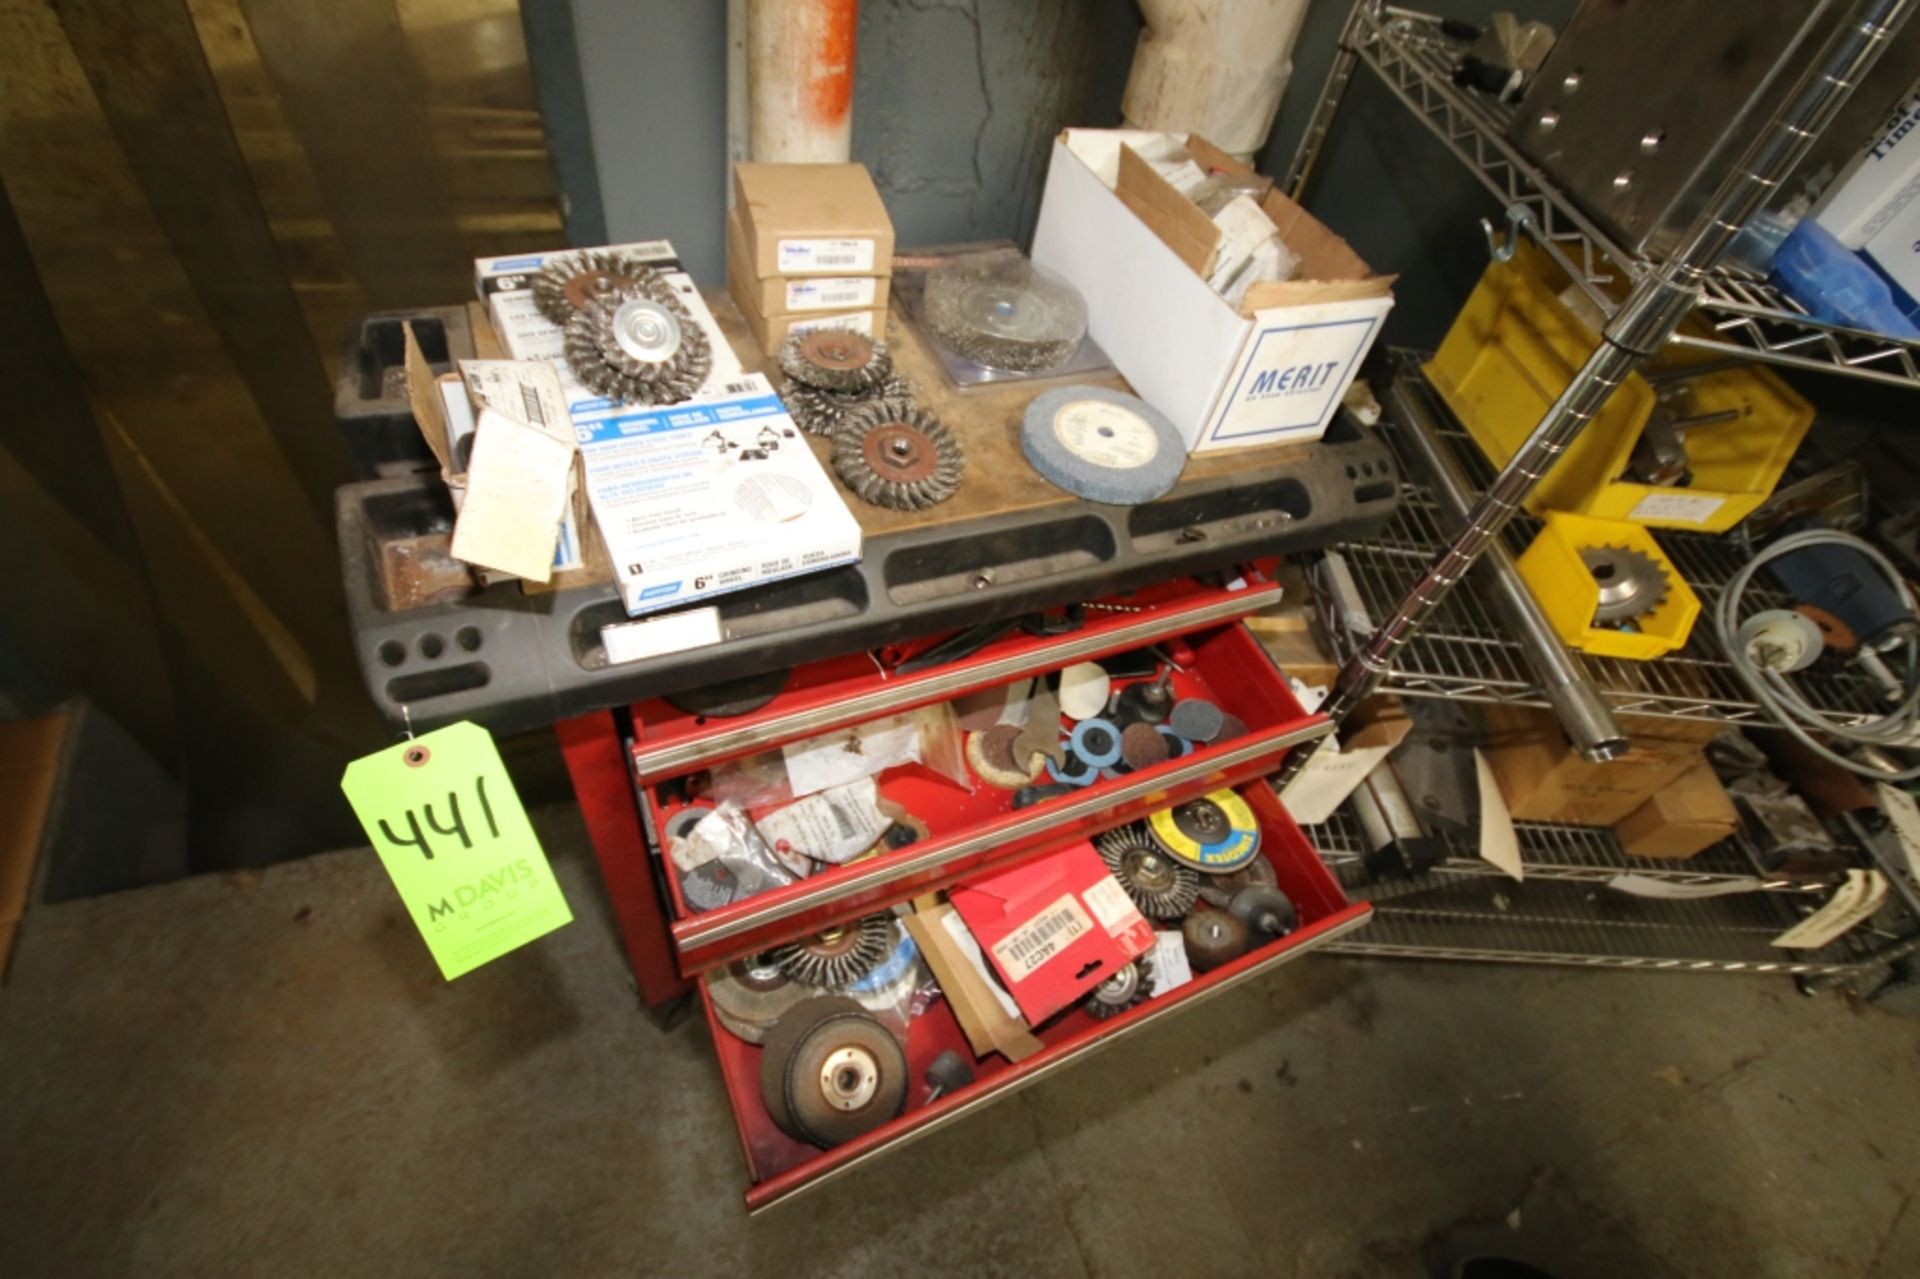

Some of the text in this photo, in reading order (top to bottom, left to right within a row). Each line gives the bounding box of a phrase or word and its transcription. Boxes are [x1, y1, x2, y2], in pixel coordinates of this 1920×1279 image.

[1249, 361, 1338, 395] MERIT
[378, 775, 500, 861] 441
[454, 858, 533, 908] DAVIS
